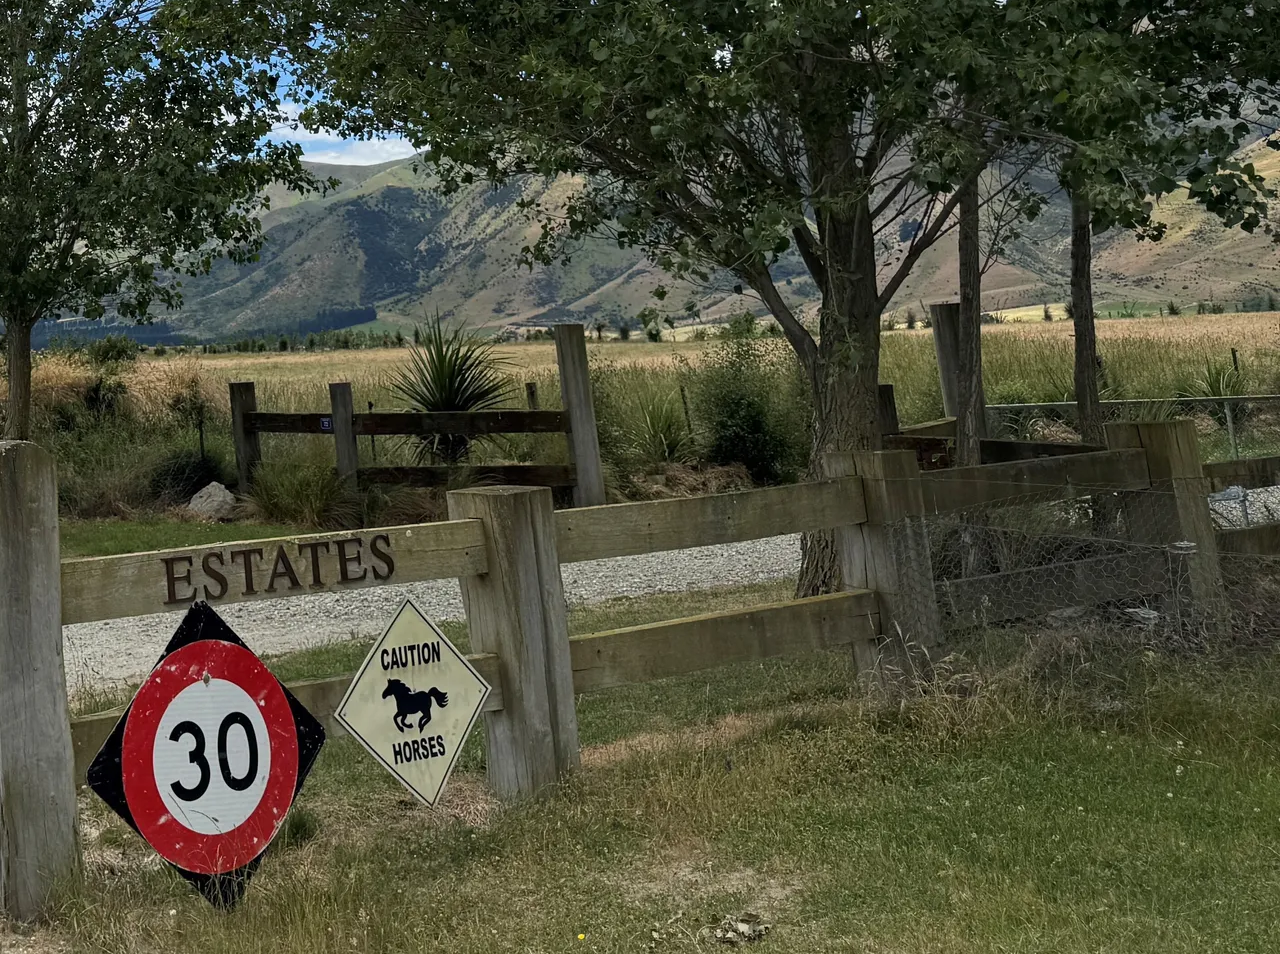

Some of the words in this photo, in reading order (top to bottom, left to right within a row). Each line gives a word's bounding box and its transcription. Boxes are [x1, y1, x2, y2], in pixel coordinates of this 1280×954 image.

[161, 534, 395, 604] ESTATES
[380, 641, 441, 671] CAUTION
[168, 711, 259, 802] 30
[392, 735, 446, 765] HORSES
